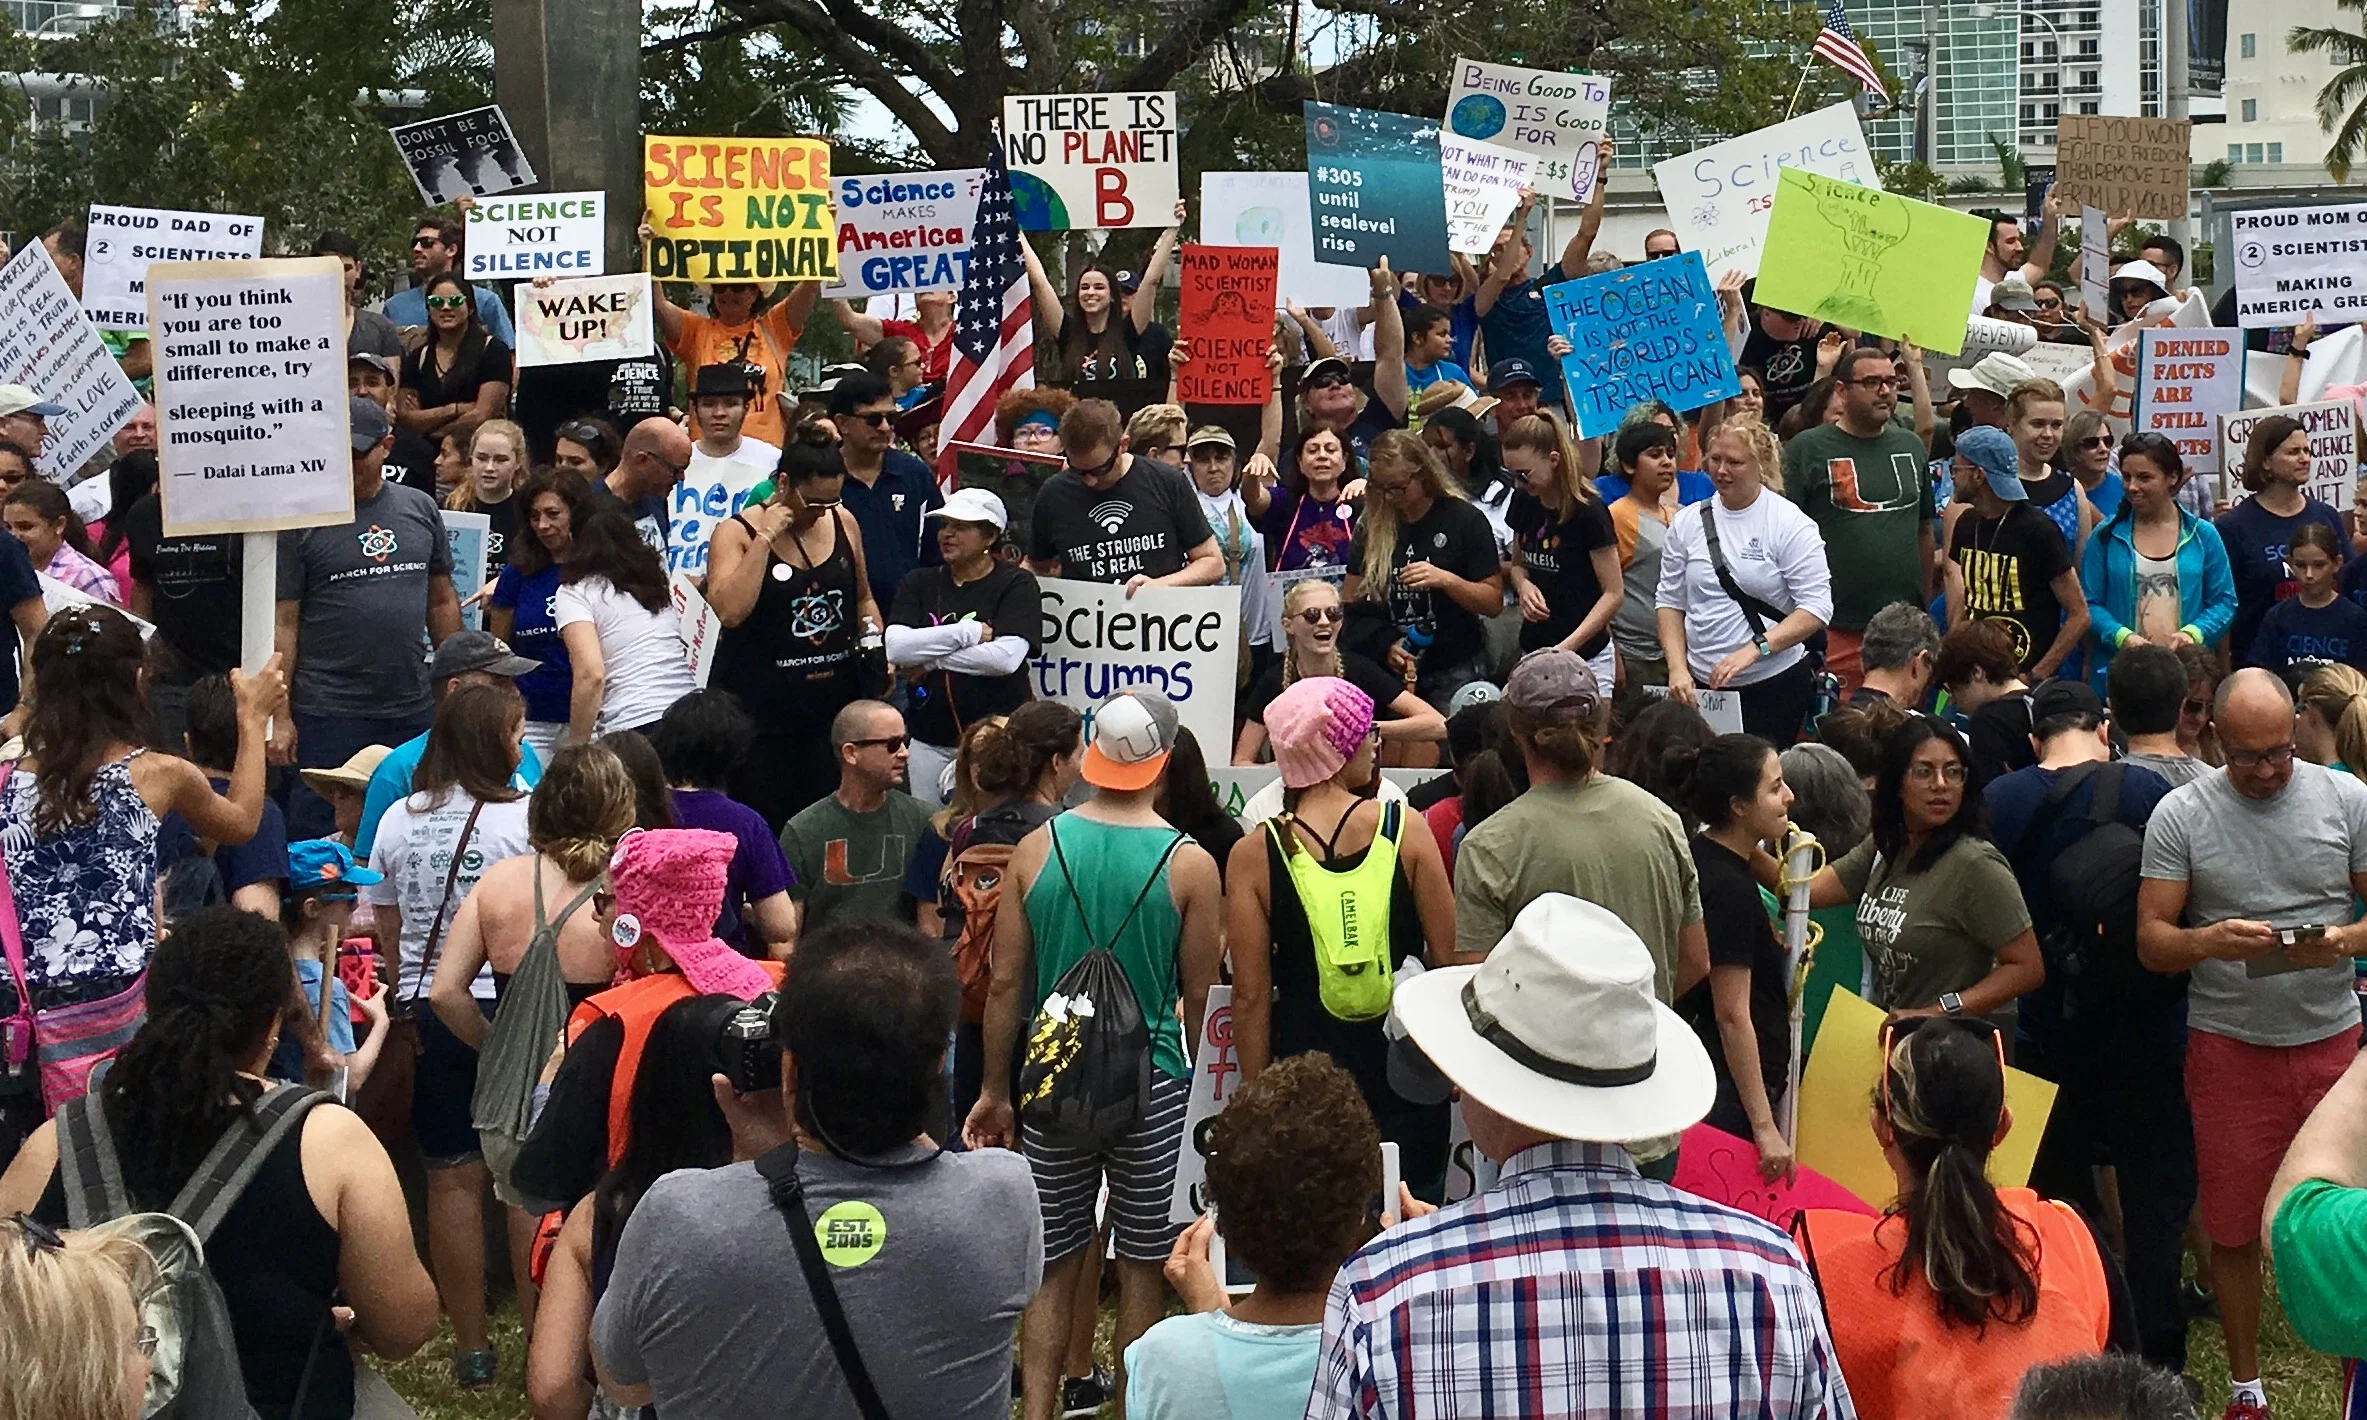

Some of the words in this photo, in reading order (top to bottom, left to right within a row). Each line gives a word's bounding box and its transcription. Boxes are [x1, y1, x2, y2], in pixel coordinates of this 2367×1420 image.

[1016, 97, 1110, 131] THERE
[1127, 95, 1165, 129] IS
[1512, 104, 1548, 122] IS
[397, 124, 448, 147] DON'T
[457, 117, 479, 134] BE
[488, 113, 499, 126] A
[1514, 127, 1557, 147] FOR
[2069, 117, 2099, 139] IF
[2103, 119, 2142, 143] YOU
[405, 142, 459, 163] FOSSIL
[465, 130, 512, 150] FOOL
[1009, 132, 1046, 166] NO
[1063, 129, 1174, 165] PLANET
[2103, 143, 2127, 160] FOR
[645, 143, 829, 189] SCIENCE
[1467, 151, 1500, 170] WHAT
[1504, 159, 1528, 176] THE
[1694, 138, 1857, 198] Science
[2060, 161, 2093, 180] THEN
[2095, 163, 2153, 183] REMOVE
[2160, 167, 2184, 185] IT
[1317, 166, 1363, 187] #305
[1463, 170, 1479, 182] DO
[1480, 173, 1500, 185] FOR
[841, 179, 956, 208] Science
[1095, 167, 1134, 227] B
[1318, 191, 1359, 208] until
[1746, 195, 1772, 214] IS
[2061, 182, 2102, 209] FROM
[469, 200, 596, 223] SCIENCE
[665, 192, 724, 228] IS
[746, 194, 828, 229] NOT
[882, 205, 937, 220] MAKES
[1453, 200, 1489, 216] YOU
[90, 212, 159, 229] PROUD
[171, 219, 211, 232] DAD
[228, 224, 255, 237] OF
[1320, 213, 1396, 234] sealevel
[1464, 221, 1491, 233] THE
[2236, 214, 2299, 229] PROUD
[2307, 212, 2350, 226] MOM
[2357, 211, 2367, 223] O
[506, 226, 562, 244] NOT
[837, 223, 964, 253] America
[1321, 233, 1356, 252] rise
[97, 242, 108, 254] 2
[650, 236, 837, 278] OPTIONAL
[1706, 237, 1756, 268] Liberal
[2247, 246, 2258, 258] 2
[2272, 240, 2367, 256] SCIENTIST
[472, 250, 592, 273] SILENCE
[862, 250, 971, 291] GREAT
[1182, 254, 1221, 270] MAD
[1227, 253, 1278, 271] WOMAN
[1194, 274, 1272, 292] SCIENTIST
[2276, 276, 2352, 292] MAKING
[28, 290, 56, 317] REAL
[195, 293, 232, 312] you
[239, 288, 293, 306] think
[537, 292, 628, 318] WAKE
[1555, 296, 1599, 321] THE
[1601, 272, 1695, 321] OCEAN
[2239, 298, 2323, 315] AMERICA
[2334, 295, 2367, 309] GRE
[37, 297, 69, 331] TRUTH
[85, 309, 145, 325] AMERI
[163, 320, 201, 337] you
[208, 317, 242, 332] are
[249, 314, 282, 330] too
[559, 319, 606, 341] UP!
[1583, 330, 1600, 348] IS
[1606, 319, 1638, 342] NOT
[1644, 308, 1681, 330] THE
[1966, 324, 2027, 345] PREVENT
[165, 339, 221, 358] small
[228, 339, 248, 355] to
[256, 336, 311, 353] make
[317, 337, 330, 350] a
[1182, 336, 1267, 361] SCIENCE
[1579, 328, 1698, 378] WORLD'S
[2154, 340, 2230, 358] DENIED
[166, 363, 277, 382] difference,
[284, 360, 313, 378] try
[1205, 363, 1239, 376] NOT
[2153, 362, 2215, 380] FACTS
[77, 371, 117, 414] LOVE
[1181, 375, 1262, 399] SILENCE
[2152, 386, 2193, 403] ARE
[169, 400, 256, 421] sleeping
[262, 398, 304, 416] with
[311, 399, 323, 412] a
[2151, 412, 2207, 429] STILL
[2299, 406, 2349, 434] OMEN
[171, 422, 283, 445] mosquito.”
[2176, 439, 2211, 455] CTS
[2310, 434, 2354, 458] CIENCE
[203, 464, 246, 480] Dalai
[250, 464, 296, 478] Lama
[300, 458, 327, 473] XIV
[2315, 459, 2348, 480] AND
[1068, 544, 1093, 562] THE
[1097, 532, 1165, 558] STRUGGLE
[330, 568, 367, 582] MARCH
[369, 565, 391, 575] FOR
[1091, 561, 1105, 577] IS
[1110, 554, 1145, 574] REAL
[516, 627, 548, 637] ARCH
[1041, 591, 1222, 653] Science
[807, 655, 825, 664] FOR
[1881, 886, 1909, 904] LIFE
[1341, 891, 1359, 948] CAMELBAK
[827, 1219, 873, 1233] EST.
[826, 1233, 873, 1248] 2005
